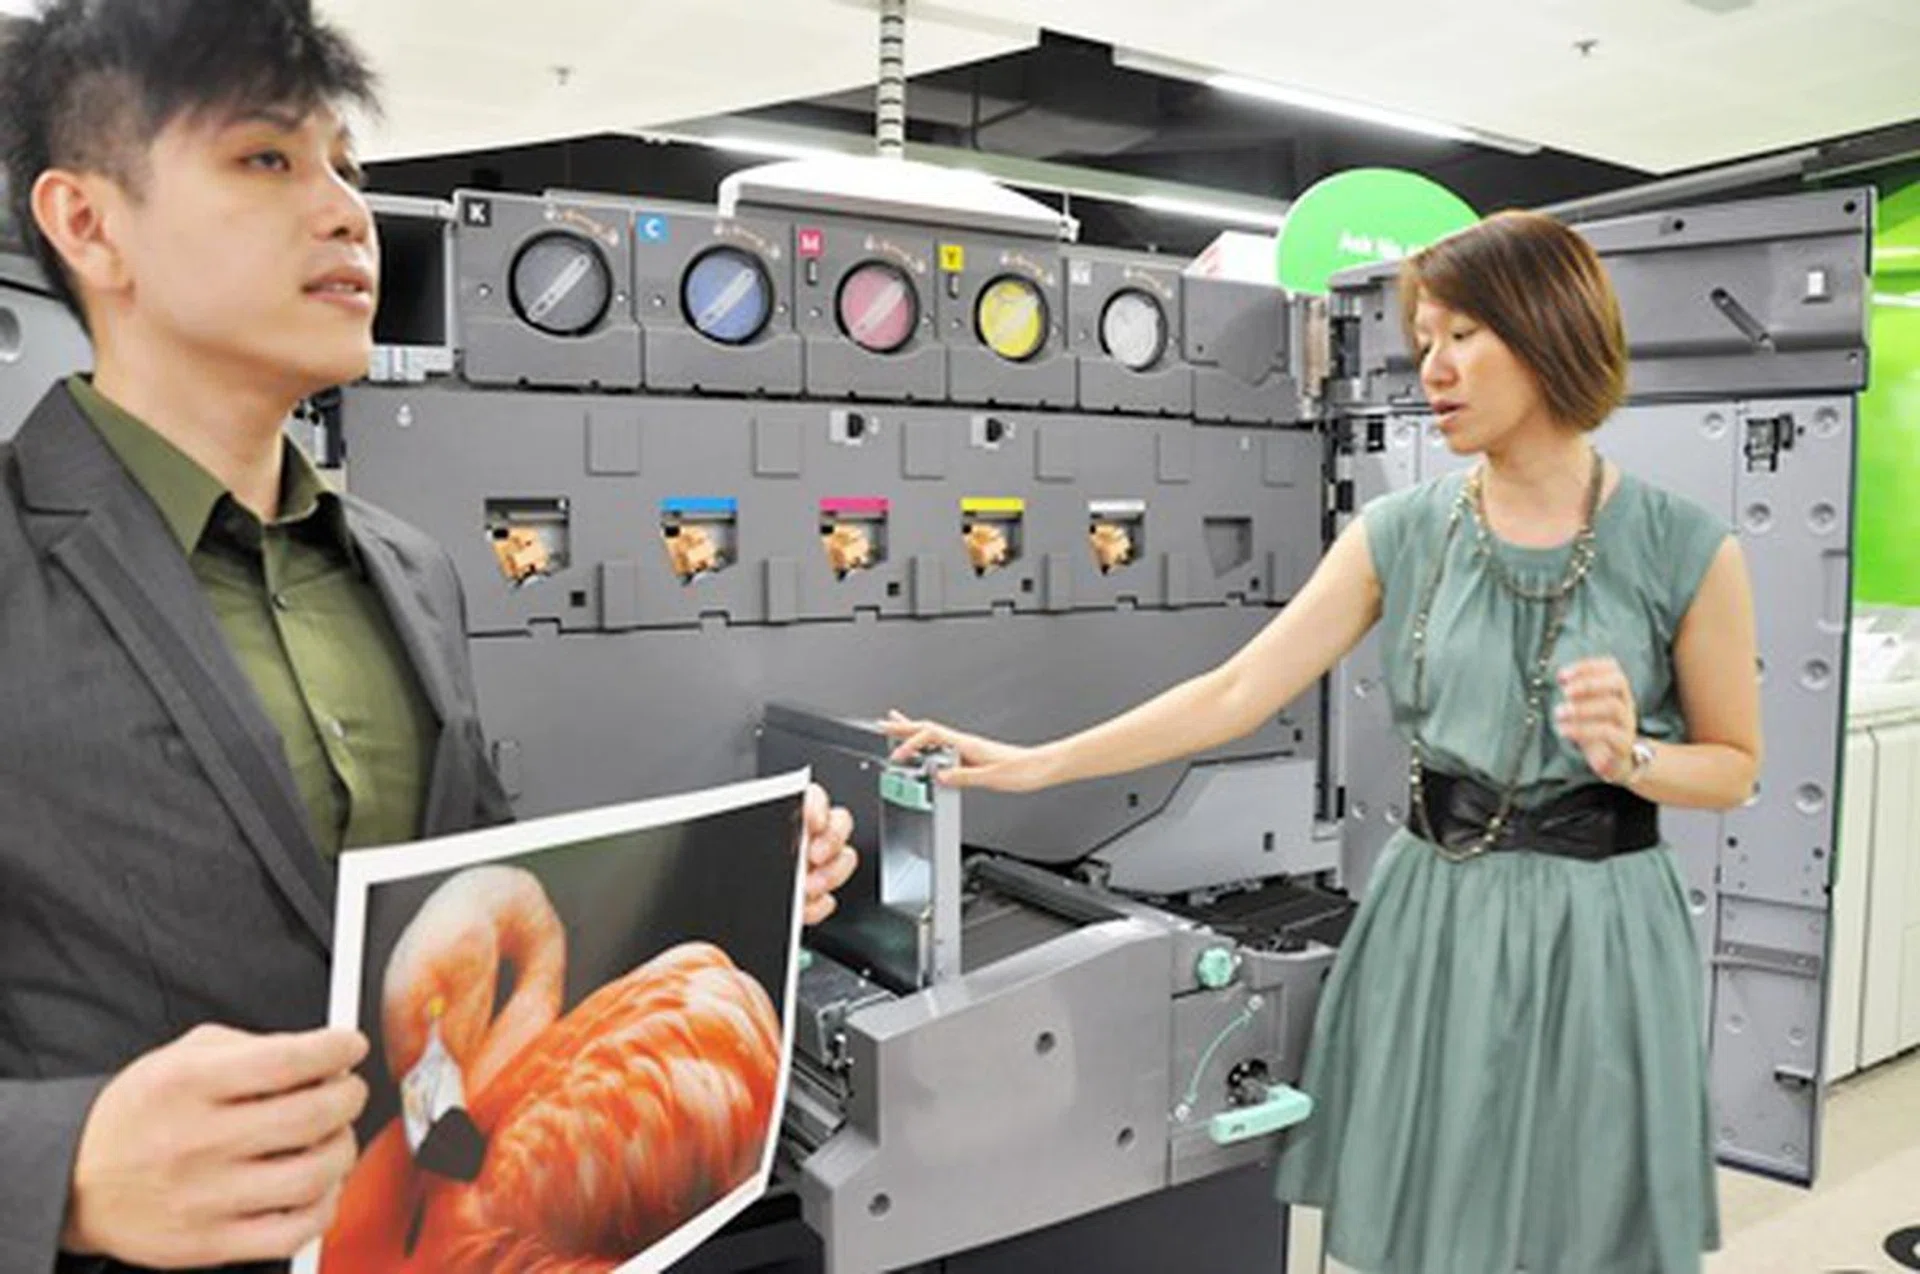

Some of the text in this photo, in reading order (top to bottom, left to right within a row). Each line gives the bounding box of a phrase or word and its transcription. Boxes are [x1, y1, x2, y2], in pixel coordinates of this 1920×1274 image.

[468, 202, 487, 223] K
[645, 217, 662, 238] C
[801, 235, 820, 252] M
[946, 250, 958, 264] Y
